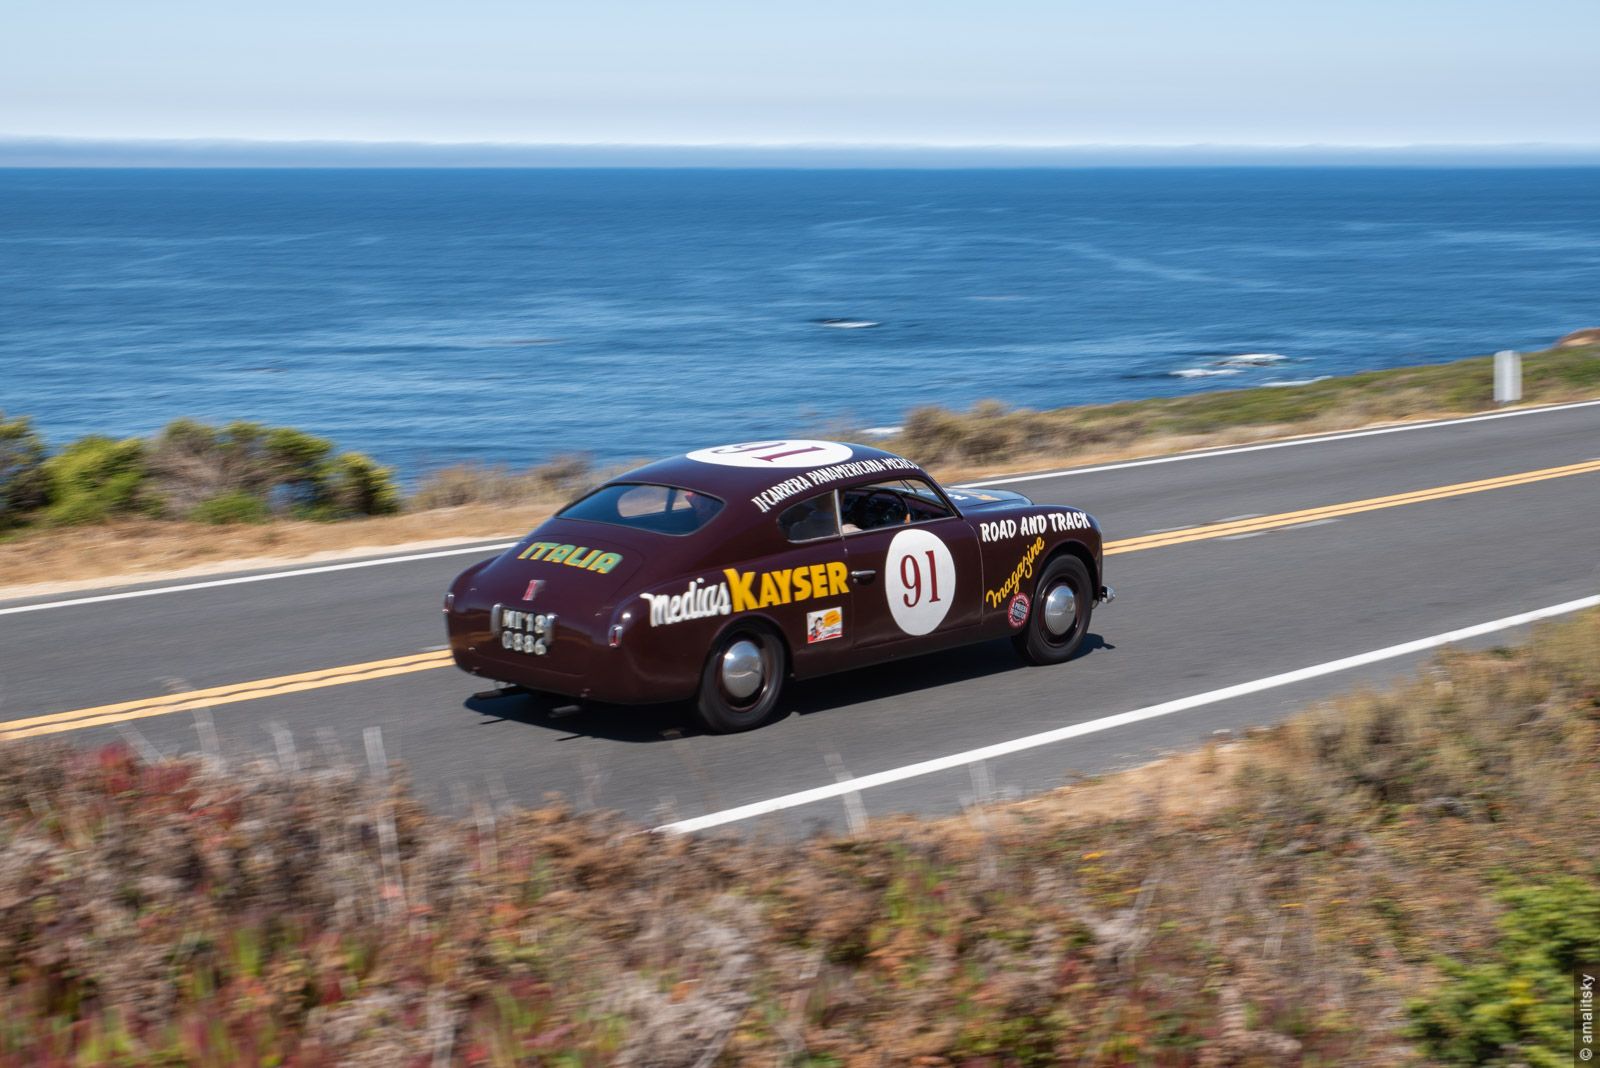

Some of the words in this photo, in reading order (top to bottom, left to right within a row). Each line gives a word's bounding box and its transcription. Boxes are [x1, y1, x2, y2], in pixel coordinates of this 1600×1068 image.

[980, 519, 1017, 542] ROAD
[1020, 514, 1048, 536] AND
[1047, 511, 1091, 532] TRACK
[517, 541, 623, 574] ITALIA
[900, 550, 941, 608] 91
[639, 577, 732, 628] medias
[722, 561, 850, 613] KAYSER
